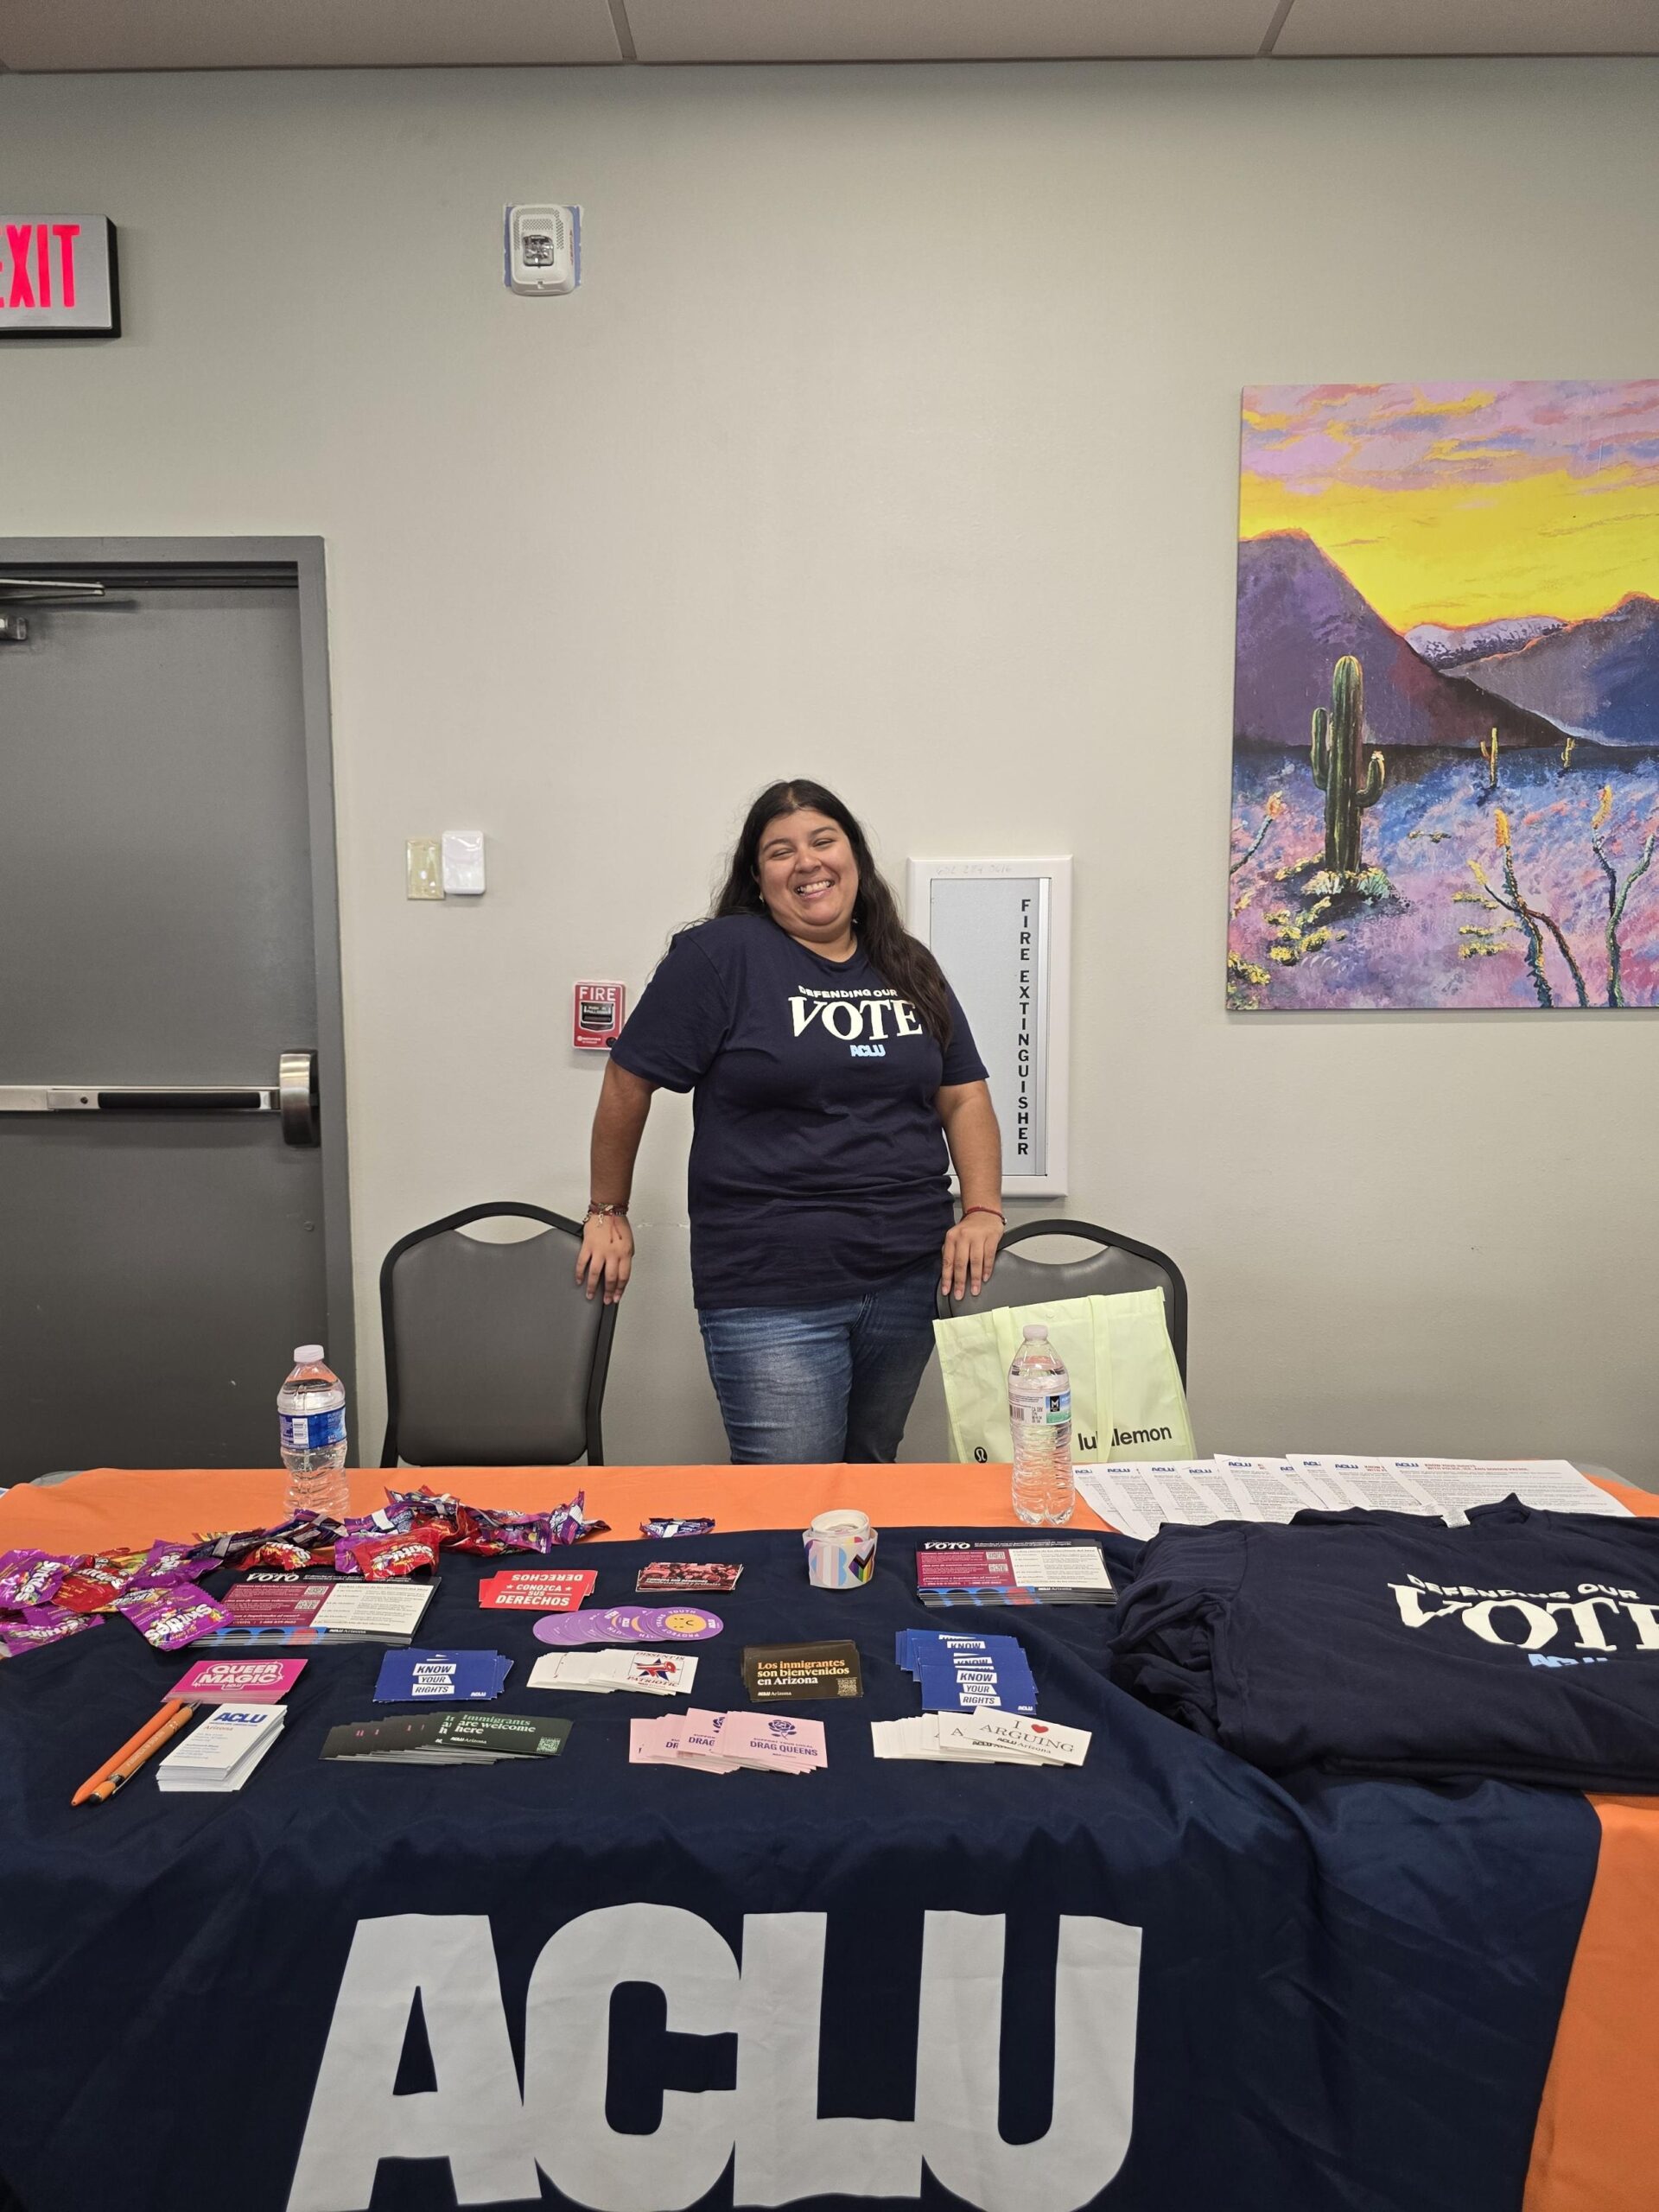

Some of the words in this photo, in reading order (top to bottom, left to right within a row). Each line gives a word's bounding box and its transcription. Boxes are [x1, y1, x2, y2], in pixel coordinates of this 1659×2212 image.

[0, 224, 80, 308] XIT
[1020, 899, 1032, 961] FIRE
[580, 986, 616, 1001] FIRE
[798, 985, 871, 998] DEFENDING
[873, 988, 898, 997] OUR
[788, 996, 923, 1040] VOTE
[849, 1044, 887, 1057] ACLU
[1017, 969, 1030, 1155] EXTINGUISHER
[1077, 1427, 1173, 1451] lulemon
[246, 1573, 300, 1582] VOTO
[1577, 1583, 1640, 1599] OUR
[495, 1595, 570, 1606] DERECHOS
[212, 1664, 278, 1675] QUEER
[416, 1665, 452, 1674] KNOW
[779, 1659, 845, 1669] inmigrantes
[779, 1667, 849, 1676] bienvenidos
[960, 1672, 993, 1681] KNOW
[199, 1674, 276, 1683] MAGIC
[626, 1675, 679, 1687] PATRIOTIC
[773, 1676, 818, 1685] Arizona
[213, 1712, 268, 1723] ACLU
[462, 1714, 531, 1726] Immigrants
[454, 1726, 484, 1734] here
[480, 1721, 536, 1732] welcome
[980, 1724, 1074, 1752] ARGUING
[750, 1740, 777, 1751] DRAG
[779, 1745, 818, 1757] QUEENS
[1017, 1743, 1052, 1754] Arizona
[286, 1902, 1143, 2212] ACLU
